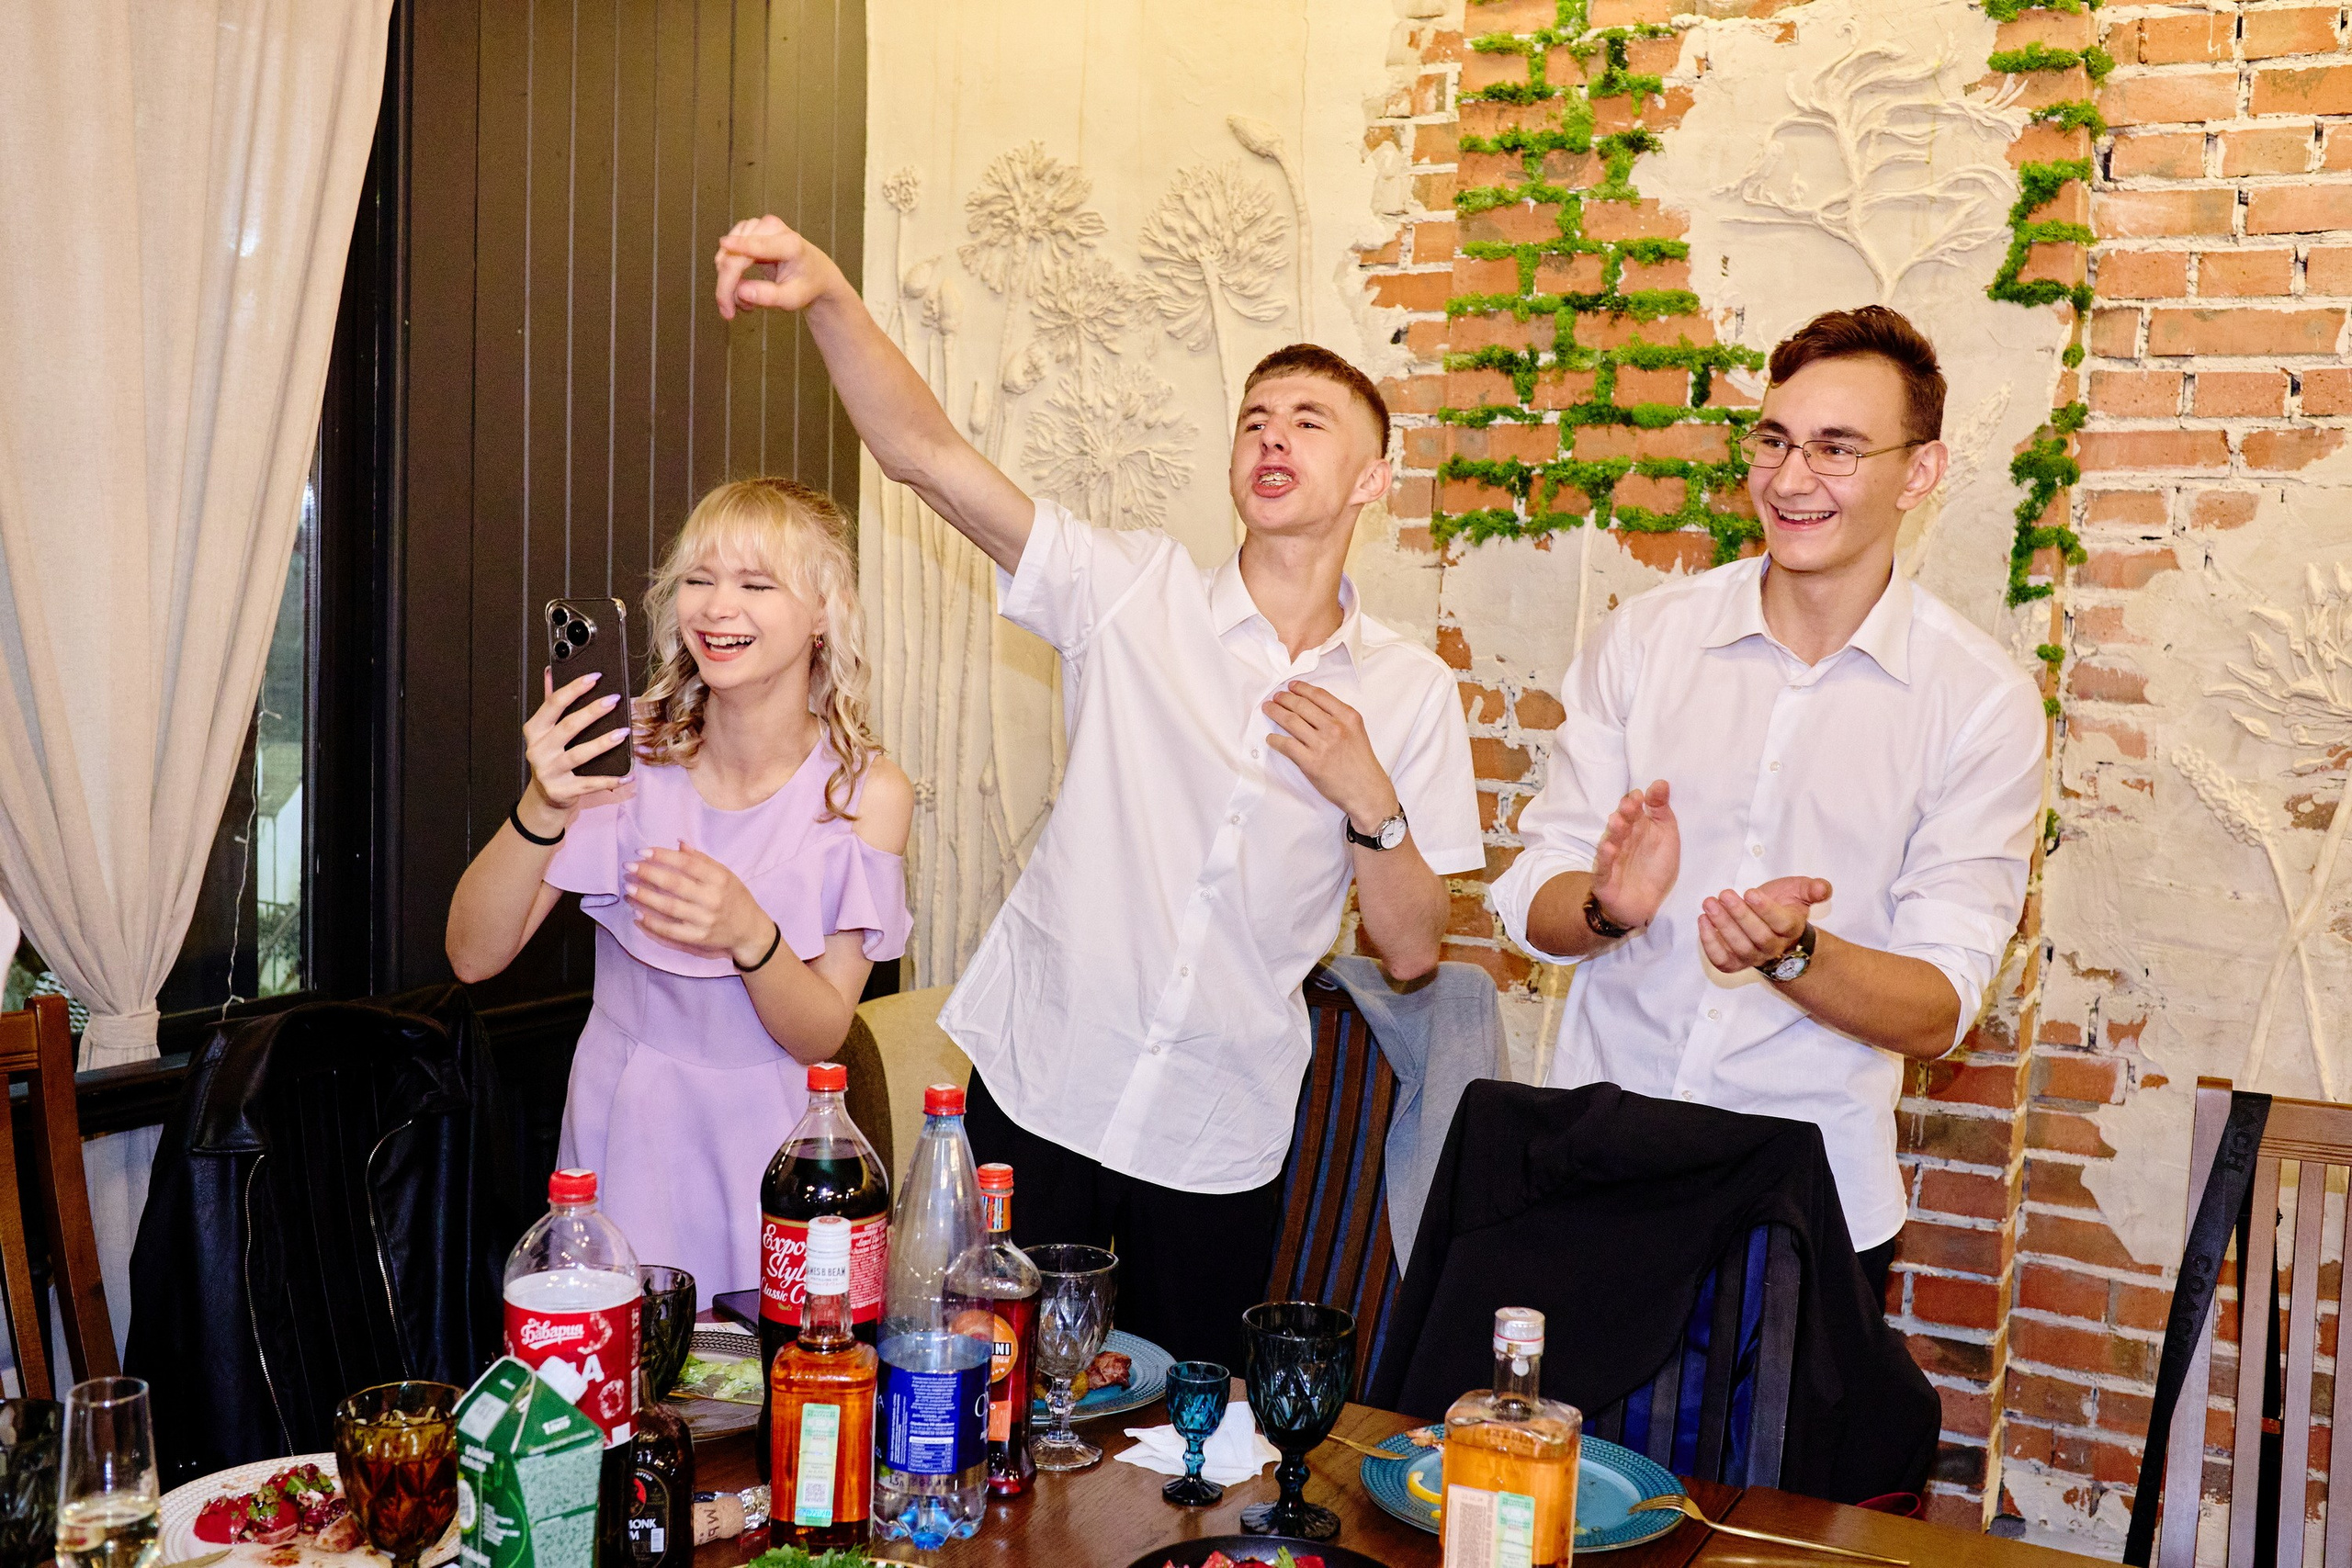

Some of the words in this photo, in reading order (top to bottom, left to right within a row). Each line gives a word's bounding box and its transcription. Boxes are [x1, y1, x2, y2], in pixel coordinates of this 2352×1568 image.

[763, 1224, 808, 1267] Expo
[766, 1251, 808, 1289] Styl
[828, 1265, 845, 1277] BEAM
[520, 1318, 585, 1348] Бавария
